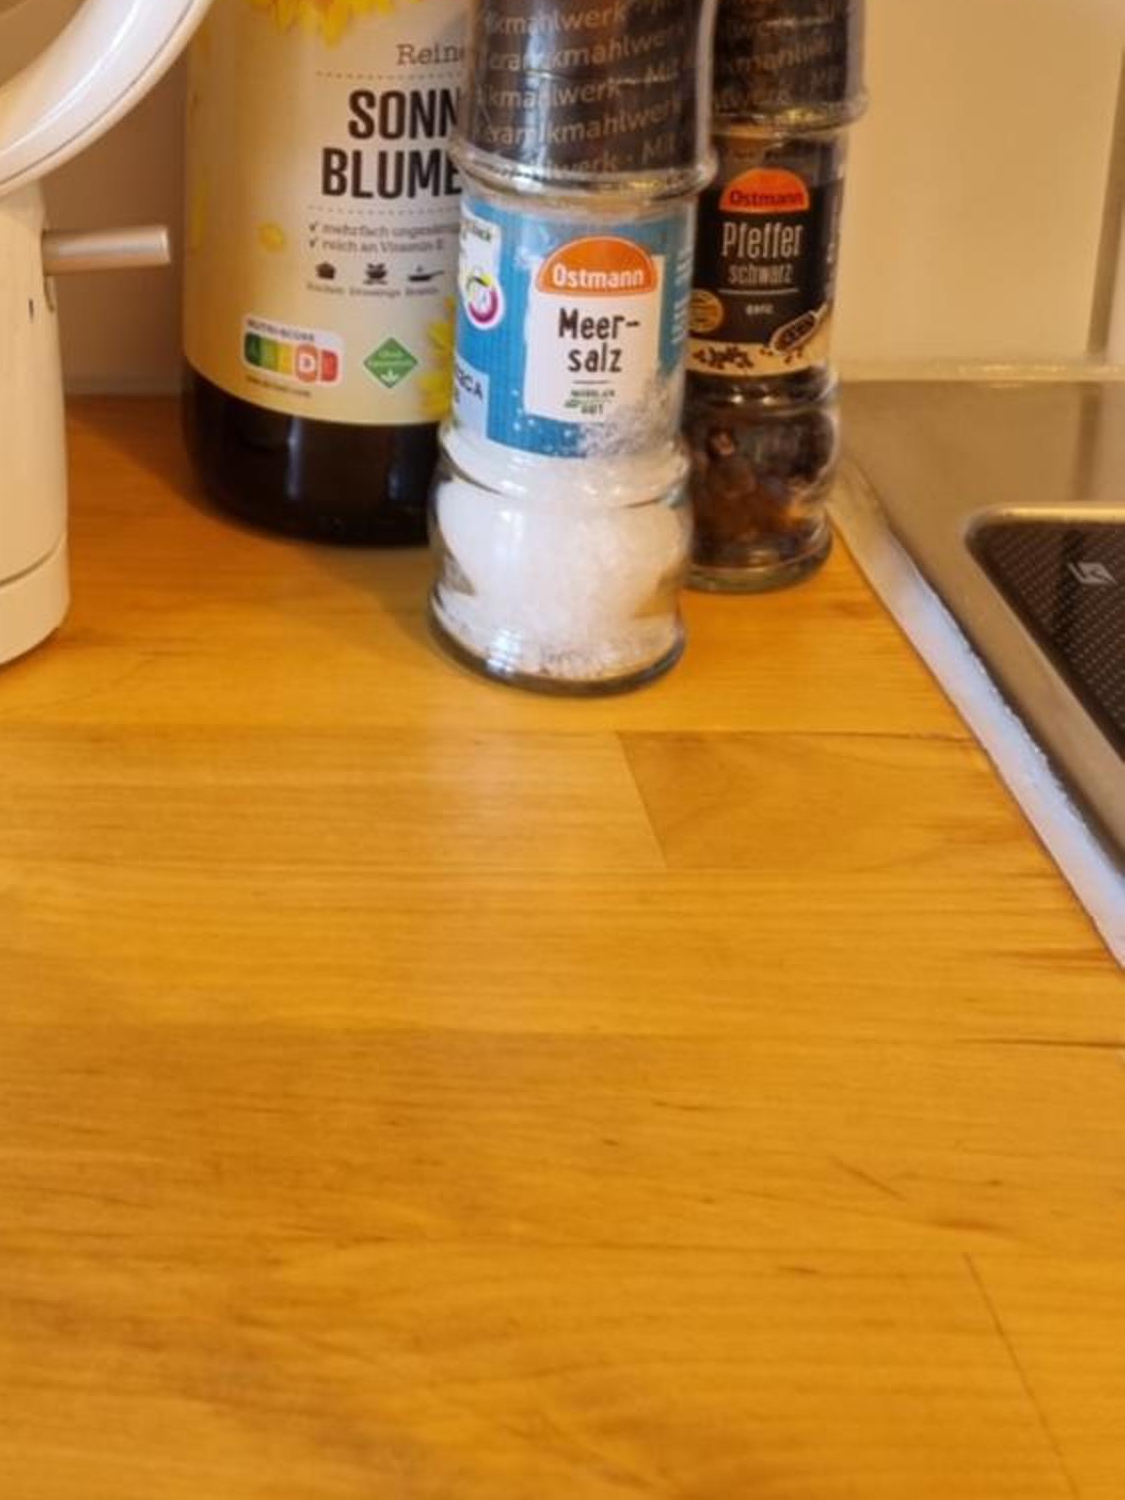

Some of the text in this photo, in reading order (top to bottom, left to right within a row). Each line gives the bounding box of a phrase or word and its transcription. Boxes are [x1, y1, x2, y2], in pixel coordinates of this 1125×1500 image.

[721, 221, 804, 259] Pfeffer
[552, 263, 644, 289] Ostmann
[558, 307, 642, 341] Meer-
[567, 342, 623, 373] salz
